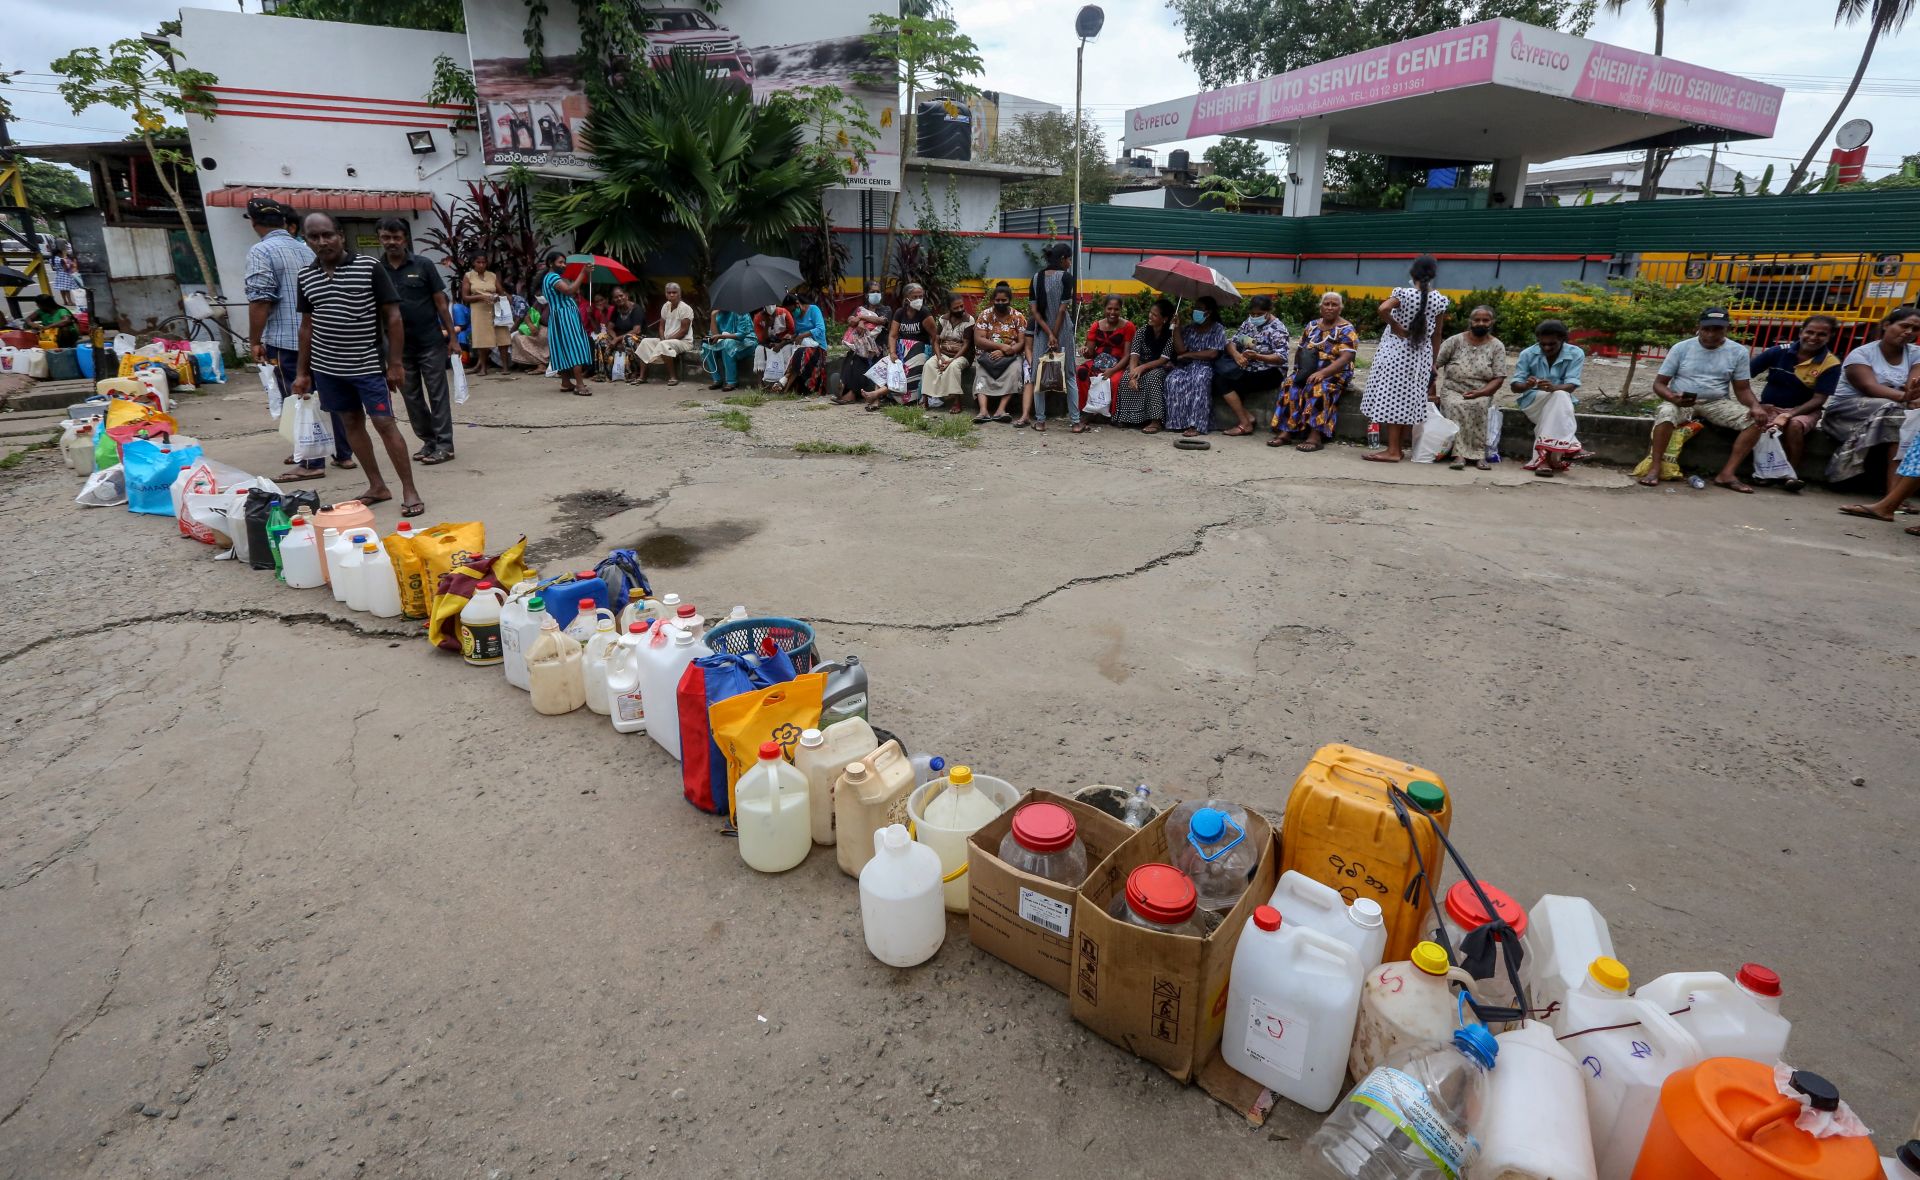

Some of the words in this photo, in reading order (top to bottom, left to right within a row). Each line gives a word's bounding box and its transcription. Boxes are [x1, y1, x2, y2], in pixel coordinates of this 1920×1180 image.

[1510, 40, 1570, 71] CEYPETCO
[1197, 90, 1256, 120] SHERIFF
[1307, 57, 1390, 95] SERVICE
[1396, 35, 1489, 76] CENTER
[1588, 56, 1649, 88] SHERIFF
[1649, 69, 1684, 97] AUTO
[1686, 78, 1736, 106] SERVICE
[1737, 90, 1778, 116] CENTER
[1370, 85, 1390, 98] 0112
[1393, 78, 1425, 93] 911361
[1133, 112, 1180, 132] CEYPETCO
[869, 178, 891, 186] CENTER
[1412, 1100, 1432, 1119] BOTTLED
